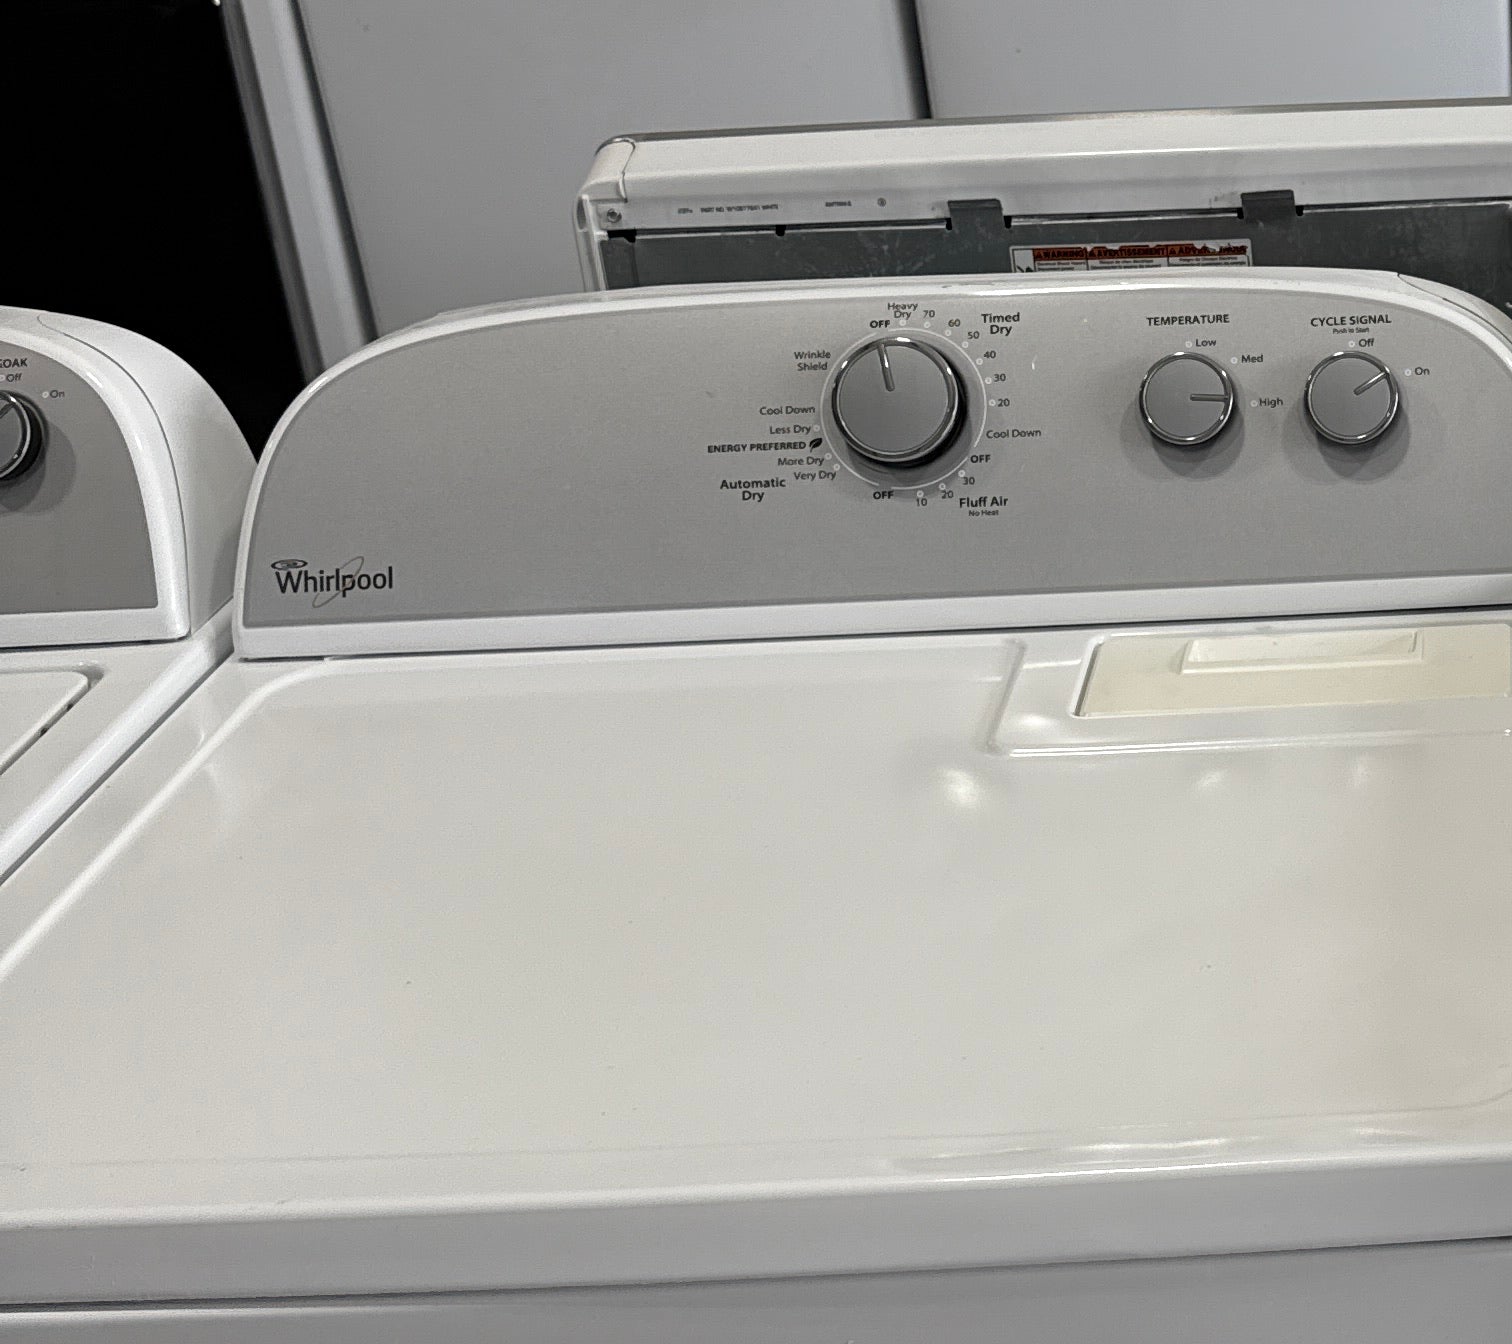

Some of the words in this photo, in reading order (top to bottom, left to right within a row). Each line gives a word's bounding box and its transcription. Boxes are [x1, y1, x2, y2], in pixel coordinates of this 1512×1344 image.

[887, 303, 918, 312] Heavy
[893, 310, 912, 320] Dry
[923, 310, 935, 318] 70
[981, 312, 1020, 323] Timed
[870, 320, 890, 328] OFF
[948, 319, 960, 327] 60
[1146, 314, 1229, 326] TEMPERATURE
[1311, 317, 1346, 327] CYCLE
[1350, 315, 1392, 325] SIGNAL
[968, 331, 979, 339] 50
[990, 325, 1012, 336] Dry
[1196, 339, 1216, 347] Low
[1359, 338, 1374, 347] Off
[794, 350, 831, 359] Wrinkle
[1242, 355, 1263, 363] Med
[798, 362, 827, 371] Shield
[1415, 367, 1430, 375] On
[6, 373, 22, 382] Off
[994, 374, 1006, 382] 30
[51, 390, 65, 398] On
[998, 398, 1010, 407] 20
[1259, 398, 1283, 408] High
[760, 406, 783, 415] Cool
[786, 406, 815, 414] Down
[770, 426, 790, 434] Less
[794, 425, 811, 435] Dry
[986, 430, 1009, 439] Cool
[1012, 429, 1041, 437] Down
[708, 444, 747, 453] ENERGY
[750, 441, 806, 451] PREFERRED
[807, 456, 824, 466] Dry
[970, 455, 990, 463] OFF
[794, 472, 816, 481] Very
[819, 470, 836, 480] Dry
[720, 478, 785, 489] Automatic
[963, 477, 975, 485] 30
[742, 491, 764, 502] Dry
[873, 490, 894, 499] OFF
[941, 490, 953, 499] 20
[916, 498, 927, 506] 10
[960, 496, 986, 508] Fluff
[990, 496, 1008, 506] Air
[275, 566, 393, 598] Whirlpool
